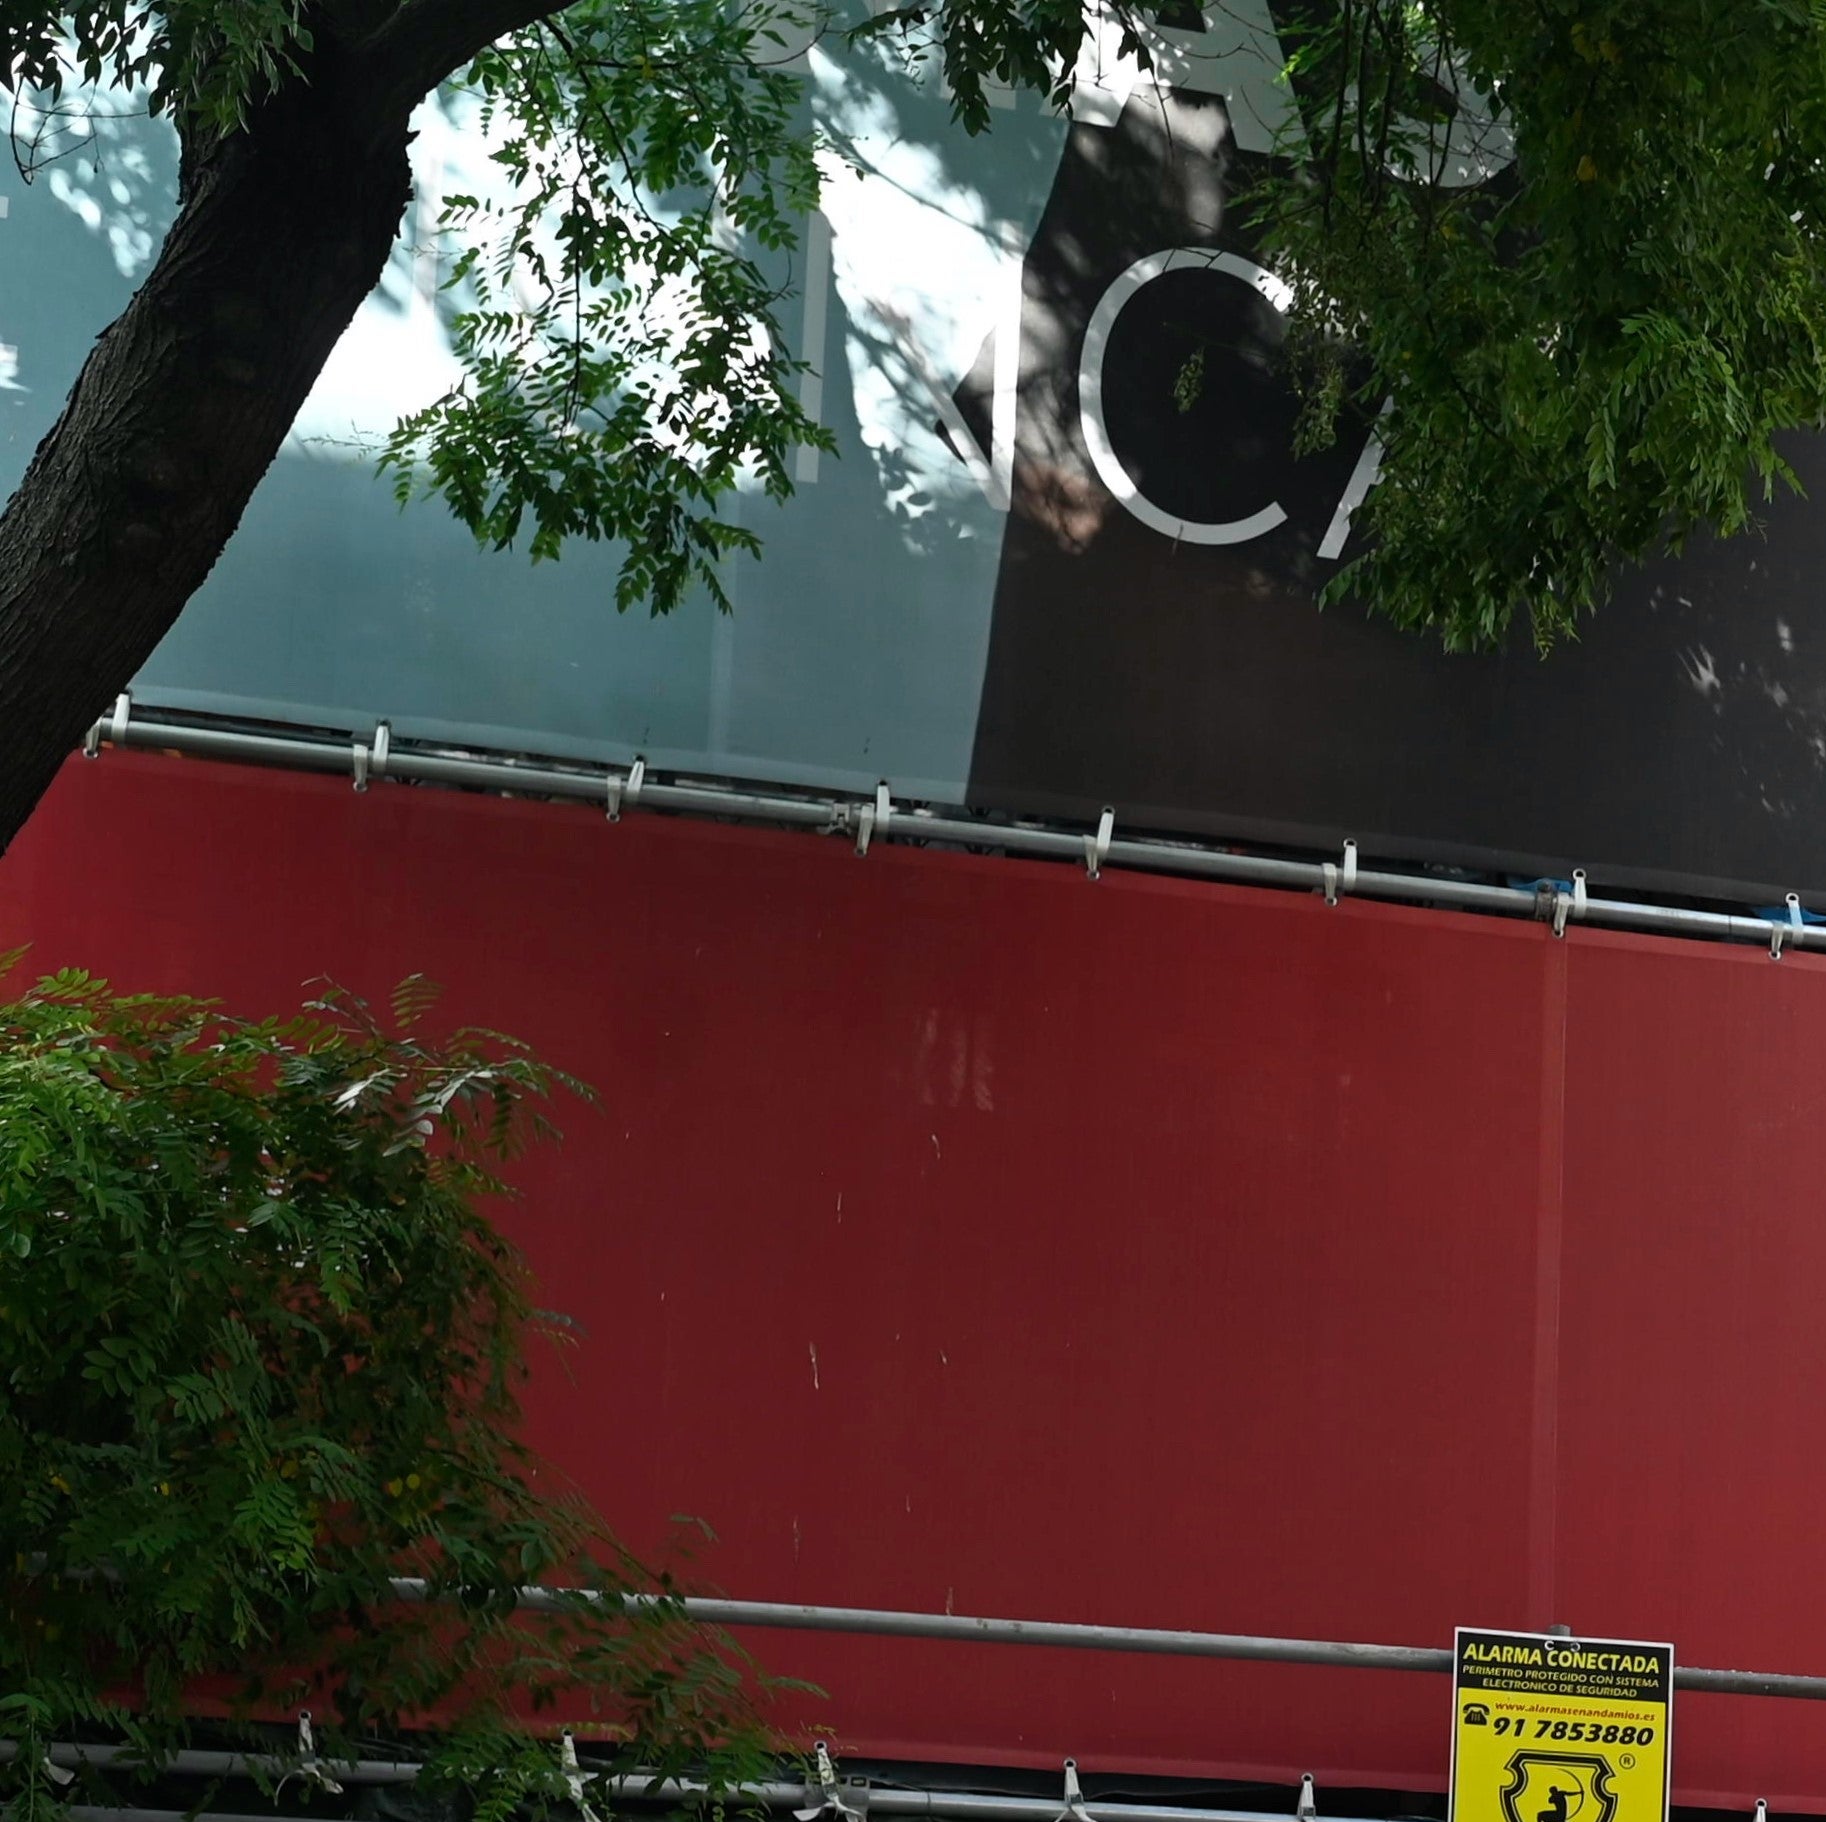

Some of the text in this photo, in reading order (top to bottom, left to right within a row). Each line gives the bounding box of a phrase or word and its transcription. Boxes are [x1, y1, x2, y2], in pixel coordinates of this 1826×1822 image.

[1463, 1643, 1660, 1674] ALARMA CONECTADA
[1462, 1665, 1660, 1688] PERIMETRO PROTEGIDO CON SISTEMA
[1482, 1678, 1638, 1697] ELECTRONICO DE SEGURIDAD
[1495, 1701, 1656, 1721] www.alarmasenandamios.es
[1493, 1717, 1654, 1746] 91 7853880
